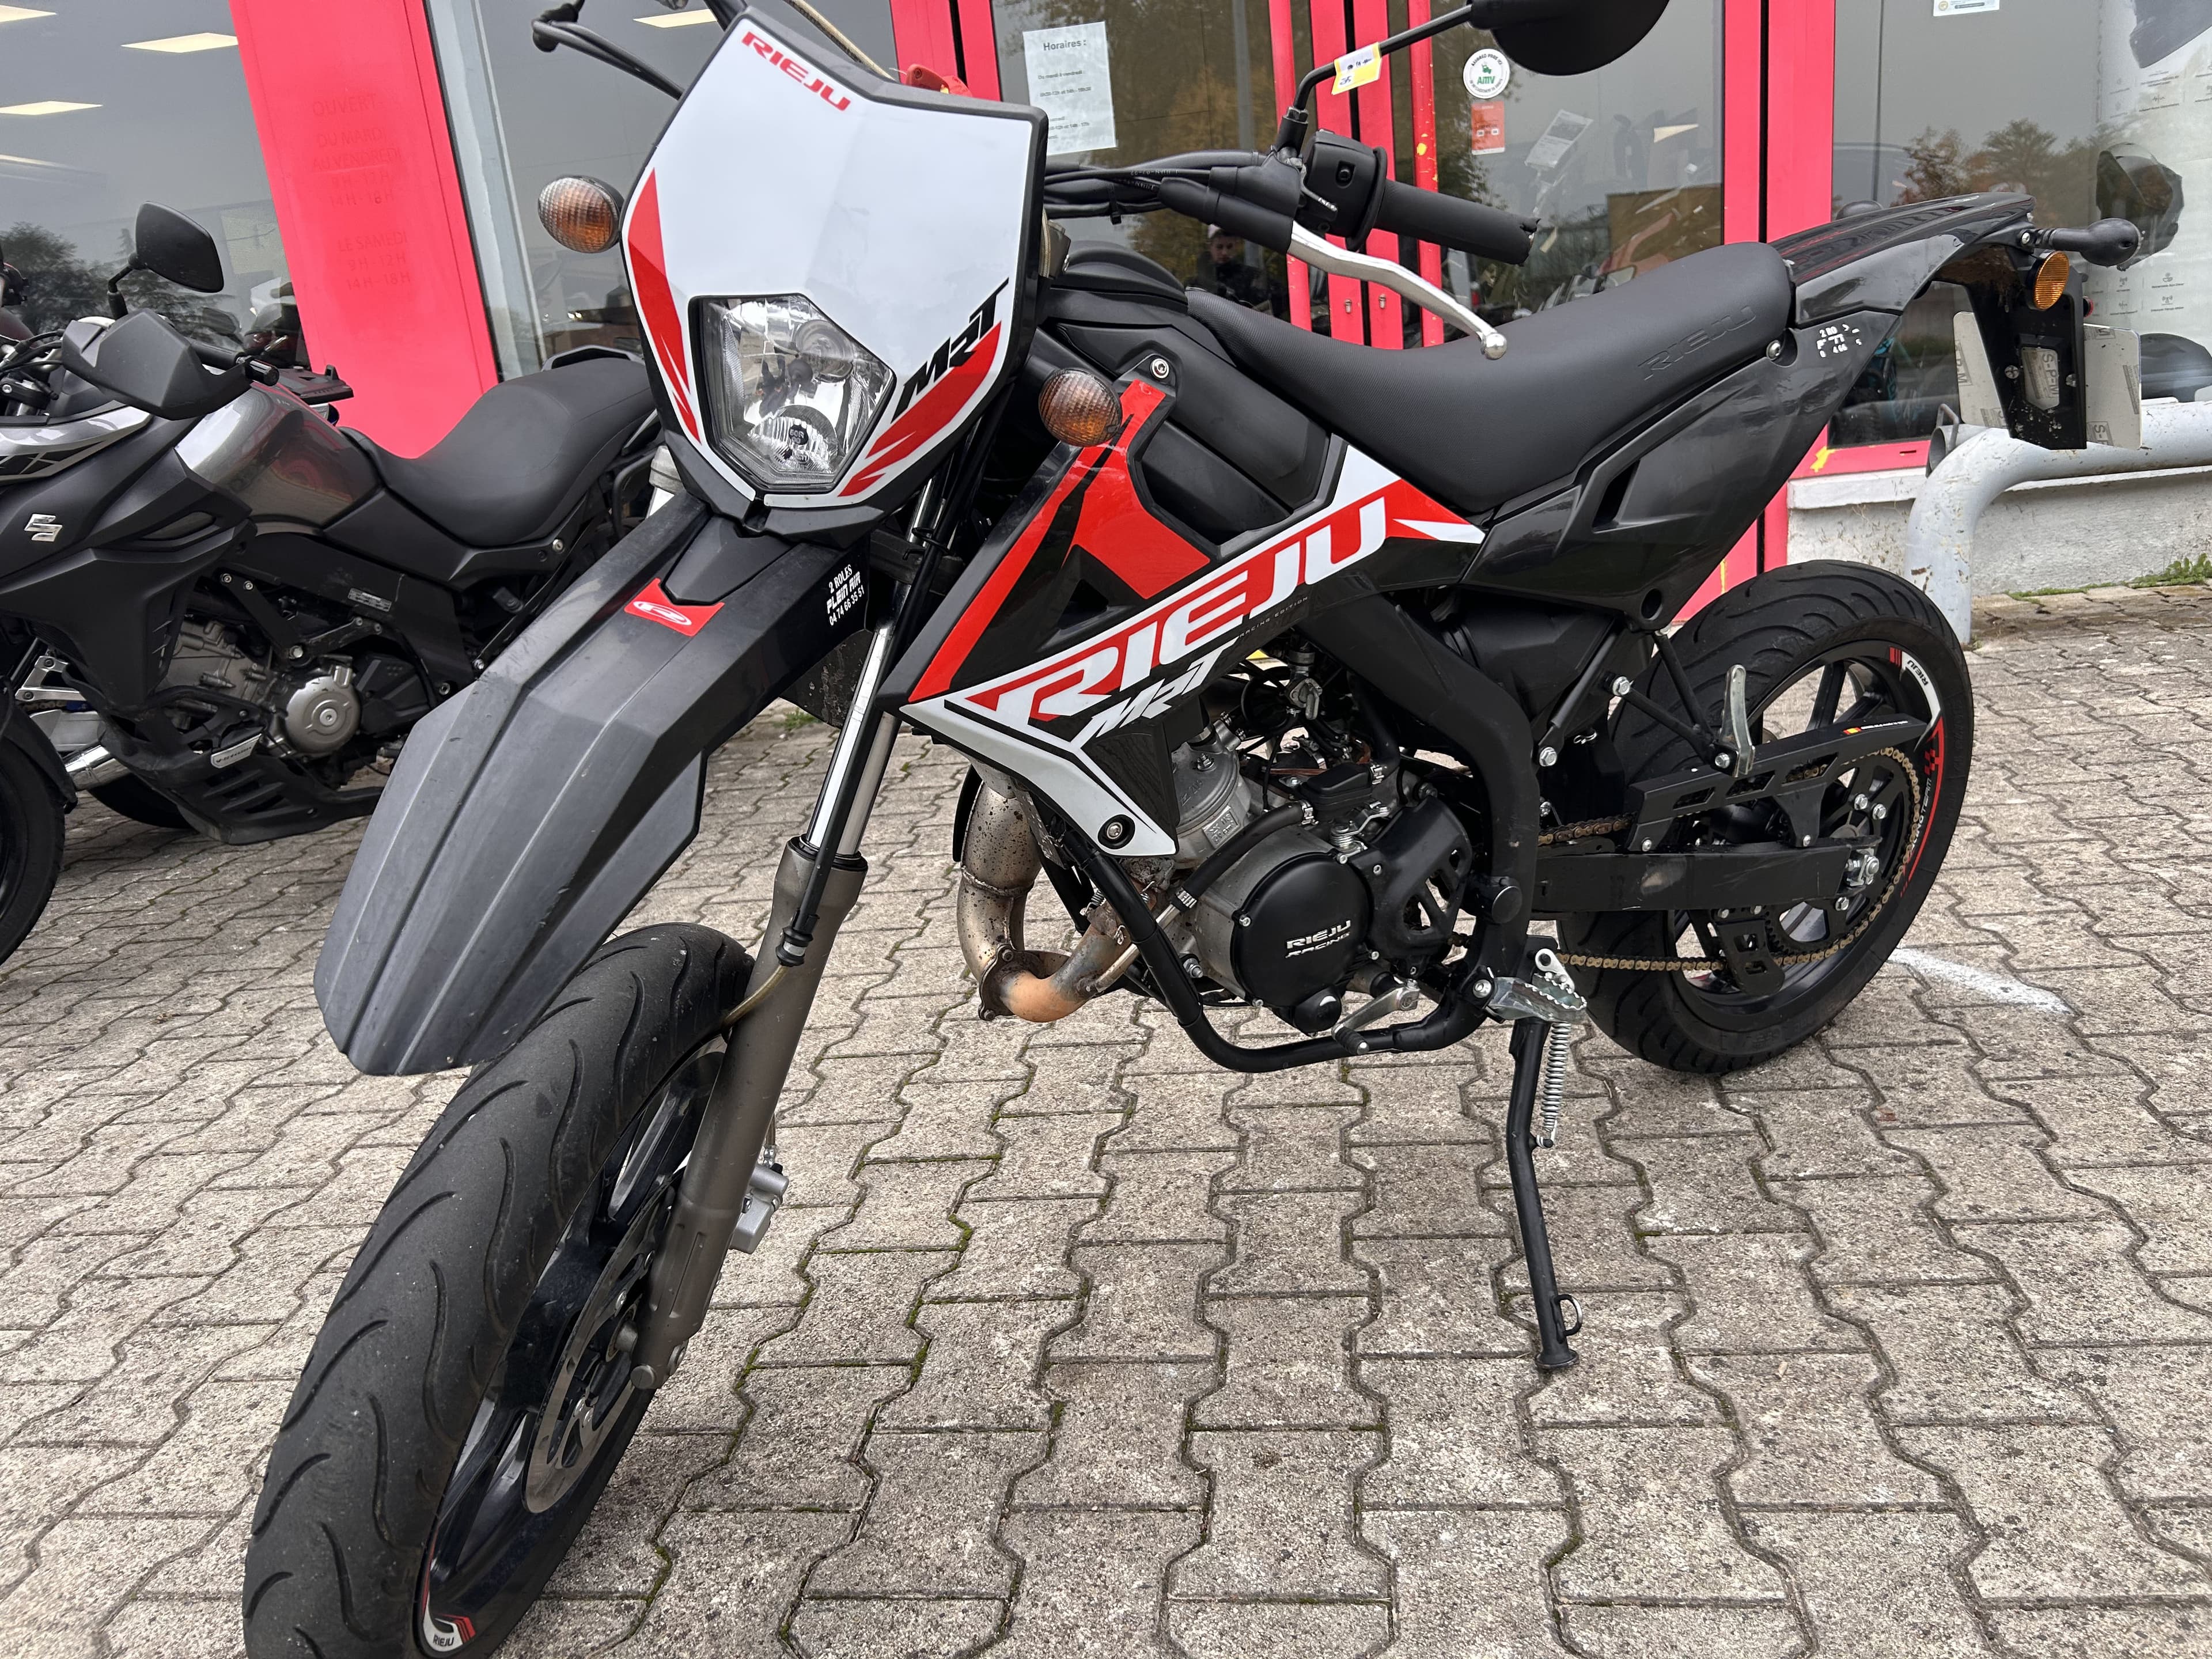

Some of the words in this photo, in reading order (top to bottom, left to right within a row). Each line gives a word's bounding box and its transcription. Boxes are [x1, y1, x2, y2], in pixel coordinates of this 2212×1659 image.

[1043, 40, 1081, 51] Horaires
[741, 31, 851, 111] RIEJU
[313, 92, 376, 117] OUVERT
[316, 132, 337, 148] DU
[342, 127, 387, 145] MARDI
[332, 147, 402, 168] VENDREDI
[355, 230, 408, 250] SAMEDI
[892, 277, 1009, 422] MRT
[1638, 305, 1756, 381] RIEJU
[828, 581, 835, 594] 2
[829, 612, 838, 626] 04
[836, 605, 844, 619] 74
[844, 598, 851, 611] 66
[851, 591, 858, 604] 35
[858, 584, 865, 598] 51
[995, 497, 1386, 726] RIEJU
[1239, 618, 1271, 638] RACING
[1274, 596, 1308, 618] EDITION
[1907, 660, 1929, 686] RIEJU
[1092, 637, 1238, 738] MRT
[1921, 777, 1932, 813] TEAM
[1285, 931, 1350, 959] RACING
[1286, 920, 1351, 949] RIEJU
[433, 1634, 454, 1647] RIEJU
